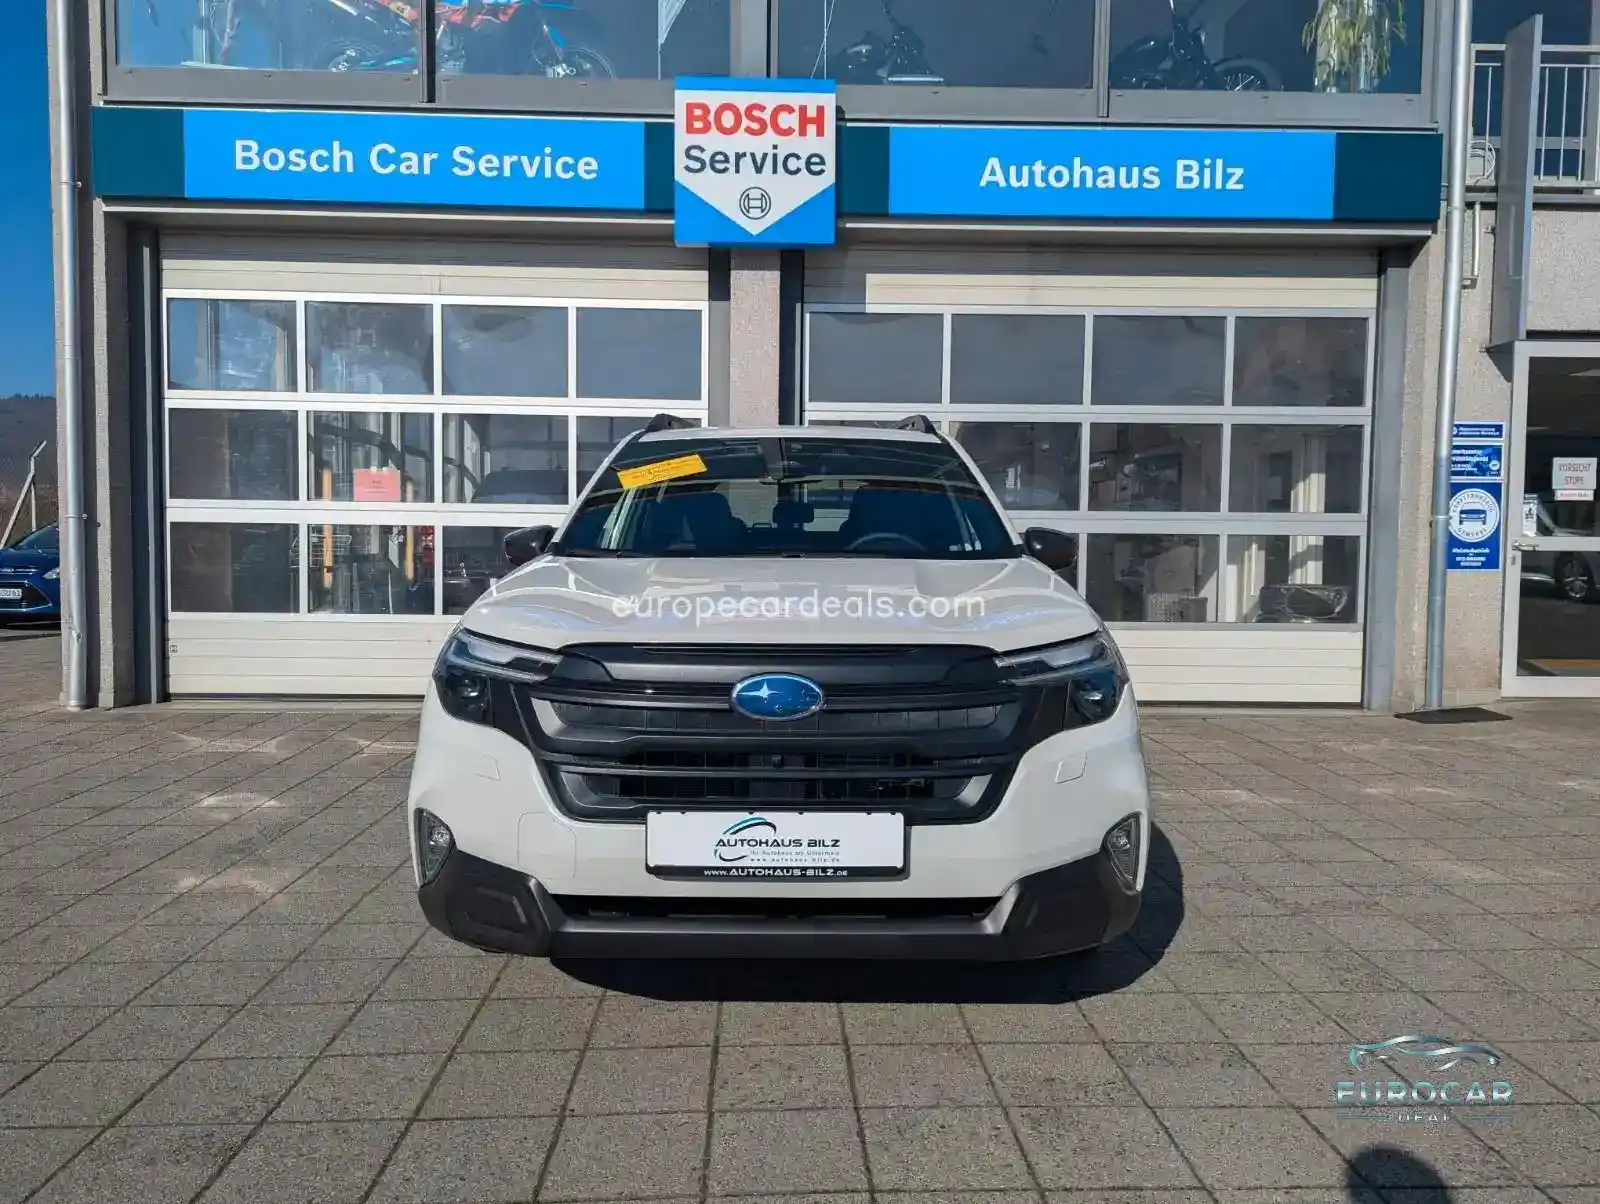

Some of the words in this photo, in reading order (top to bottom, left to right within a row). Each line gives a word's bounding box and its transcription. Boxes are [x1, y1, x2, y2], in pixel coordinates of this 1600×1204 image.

[685, 102, 825, 137] BOSCH
[235, 139, 354, 172] Bosch
[369, 142, 438, 176] Car
[452, 145, 599, 180] Service
[683, 144, 826, 176] Service
[979, 156, 1161, 189] Autohaus
[1175, 158, 1245, 190] Bilz
[715, 838, 803, 848] AUTOHAUS
[807, 838, 841, 848] BILZ
